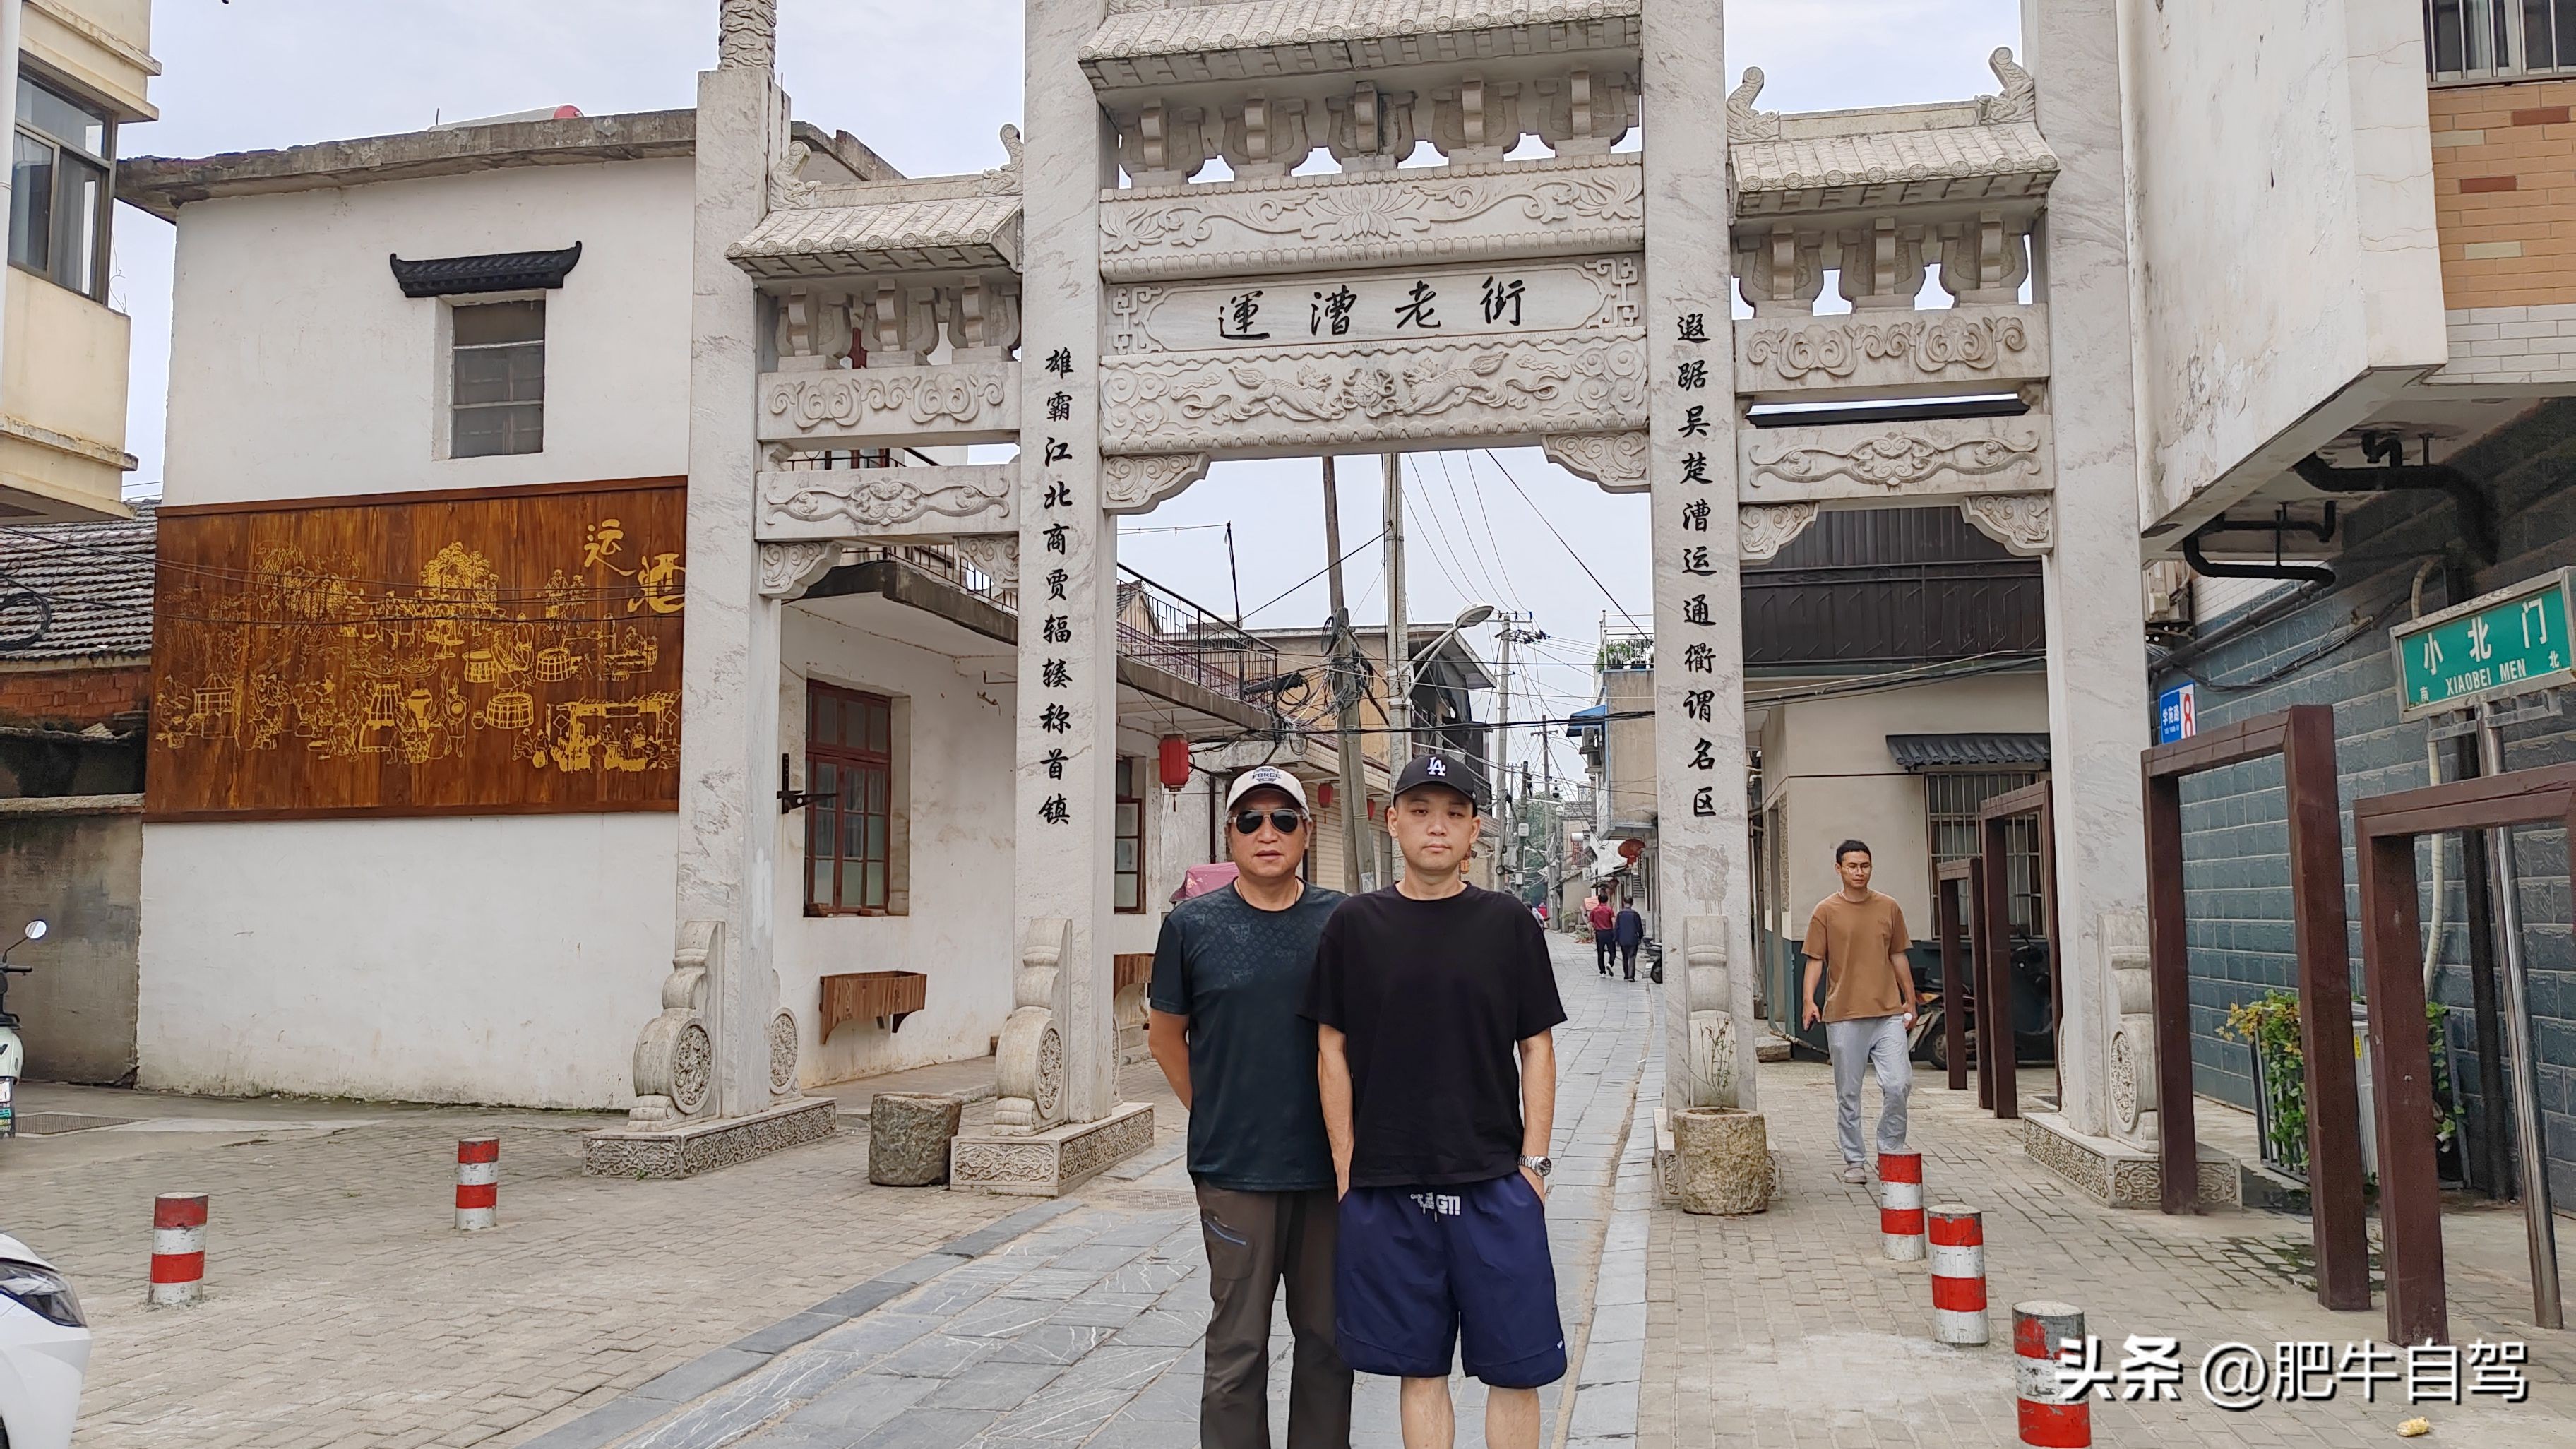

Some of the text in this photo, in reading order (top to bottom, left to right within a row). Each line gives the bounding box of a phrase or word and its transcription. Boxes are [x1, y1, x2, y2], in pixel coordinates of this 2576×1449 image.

[2423, 598, 2548, 676] 小北门
[2548, 650, 2560, 668] 北
[2445, 658, 2527, 696] XIAOBEI MEN
[2419, 686, 2430, 702] 南
[1427, 756, 1446, 777] LA
